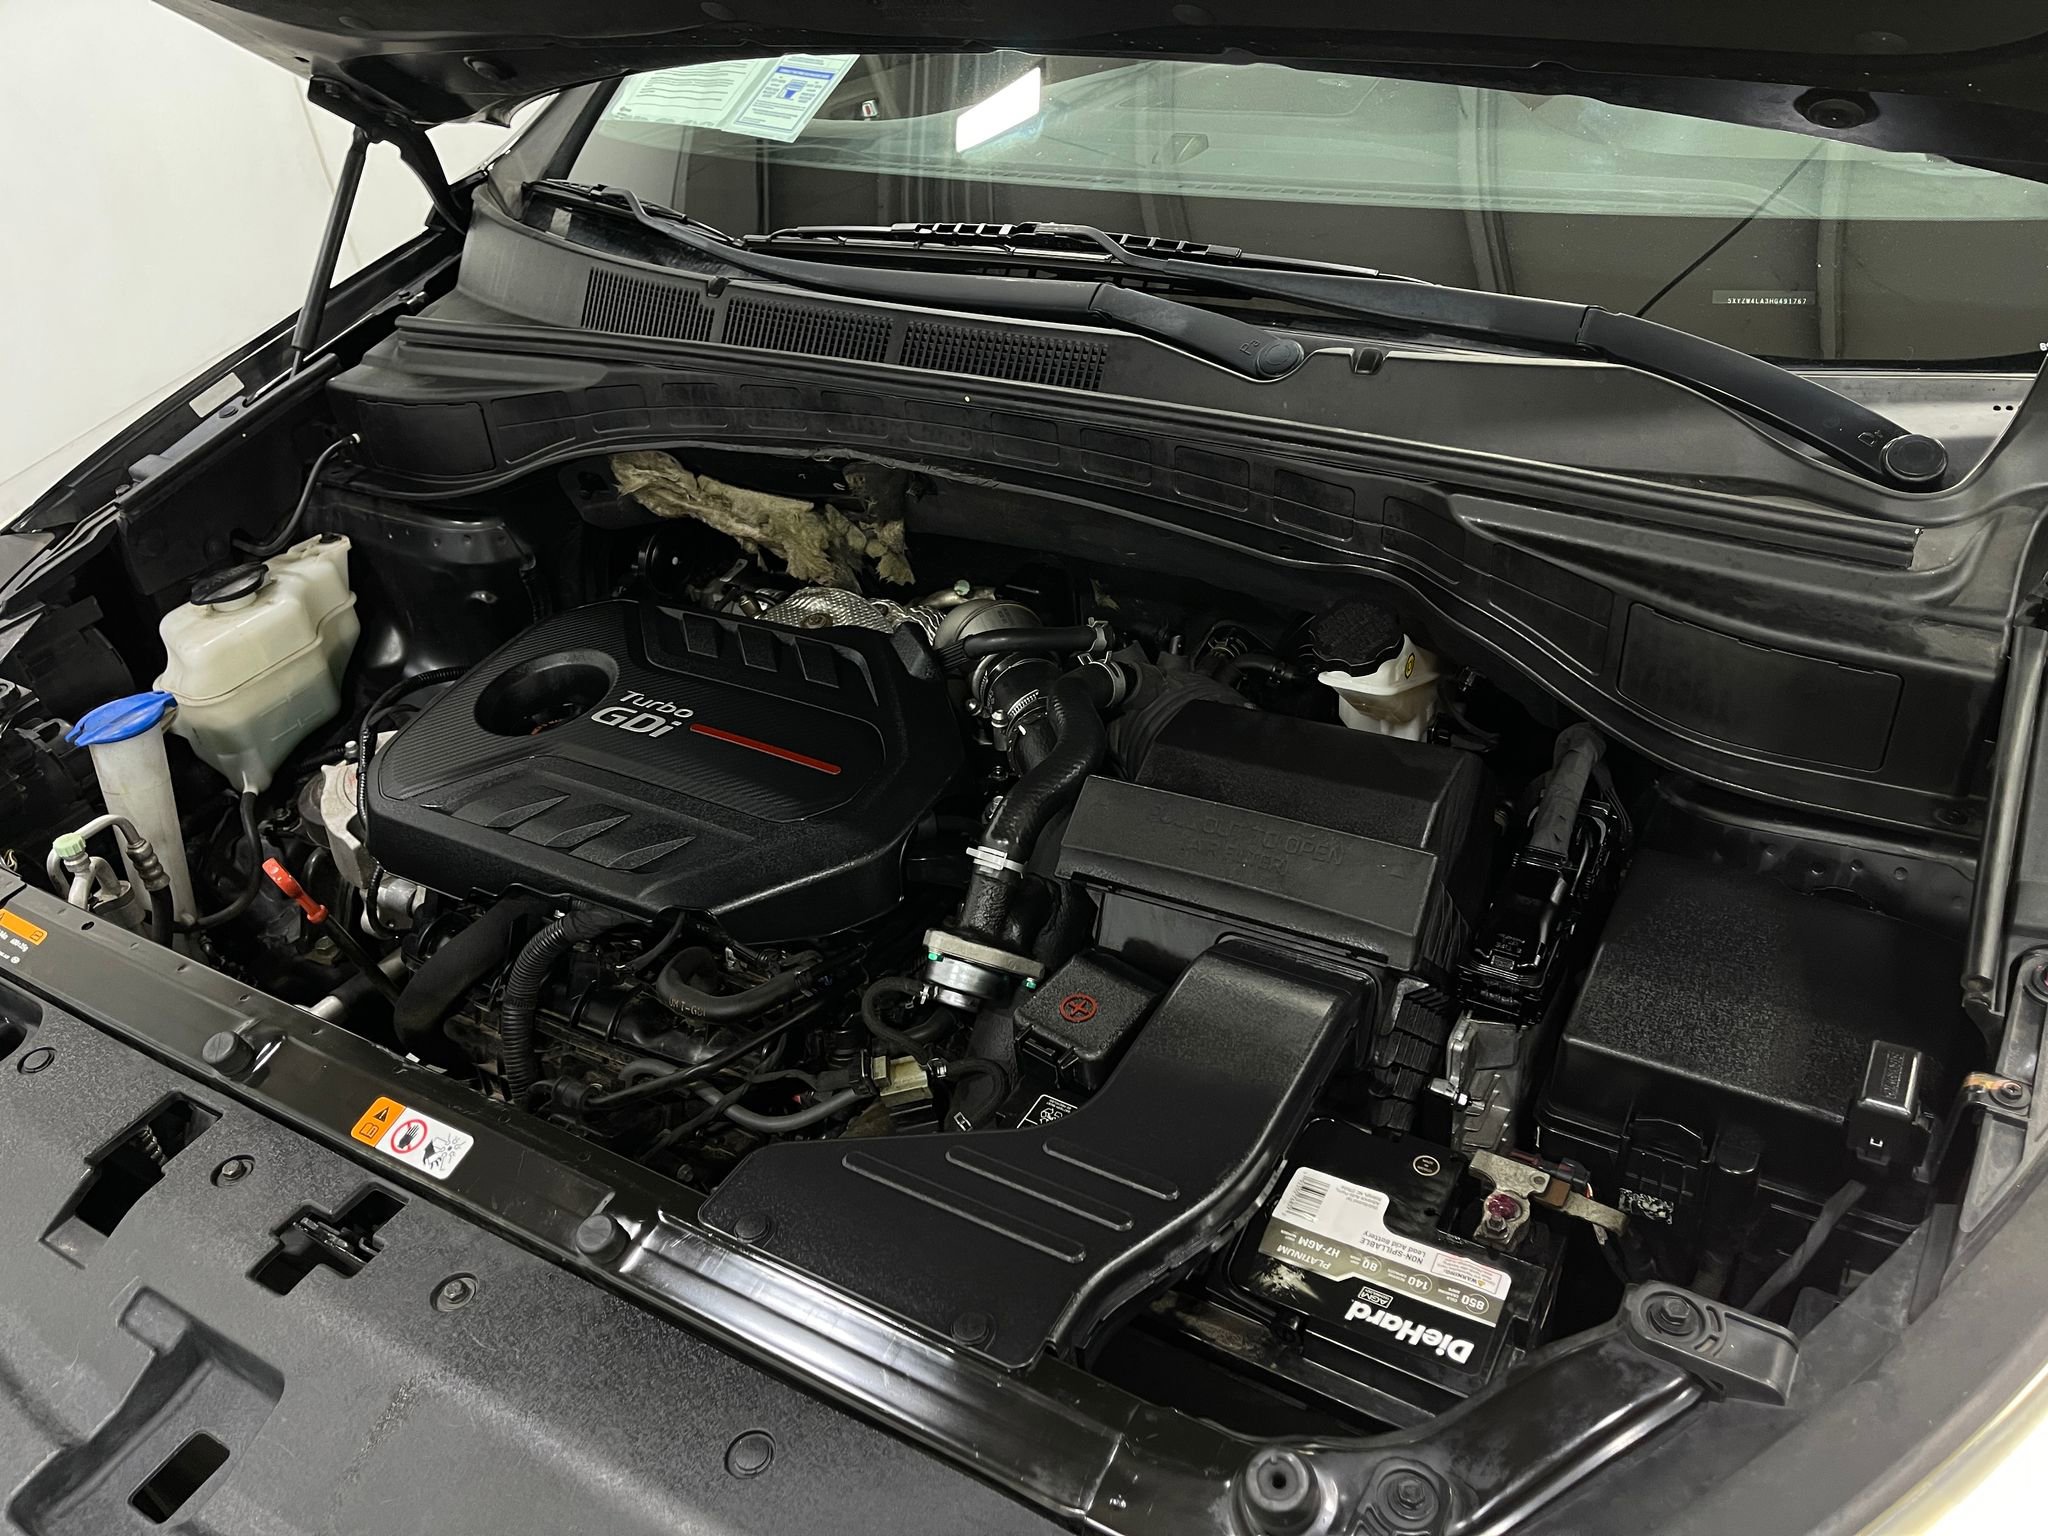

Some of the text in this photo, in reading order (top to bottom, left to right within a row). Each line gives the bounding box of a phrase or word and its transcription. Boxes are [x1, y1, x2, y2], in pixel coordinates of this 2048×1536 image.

[620, 690, 695, 719] Turbo
[591, 705, 683, 738] GDi
[1285, 836, 1345, 866] OPEN
[1276, 1243, 1332, 1271] PLATINUM
[1297, 1235, 1341, 1259] H7-AGM
[1359, 1237, 1424, 1265] NON-SPILLABLE
[1362, 1229, 1426, 1258] Lead Acid Battery
[1407, 1275, 1430, 1291] 140
[1360, 1291, 1389, 1307] AGM
[1460, 1293, 1486, 1311] 850
[1343, 1299, 1476, 1365] DieHard
